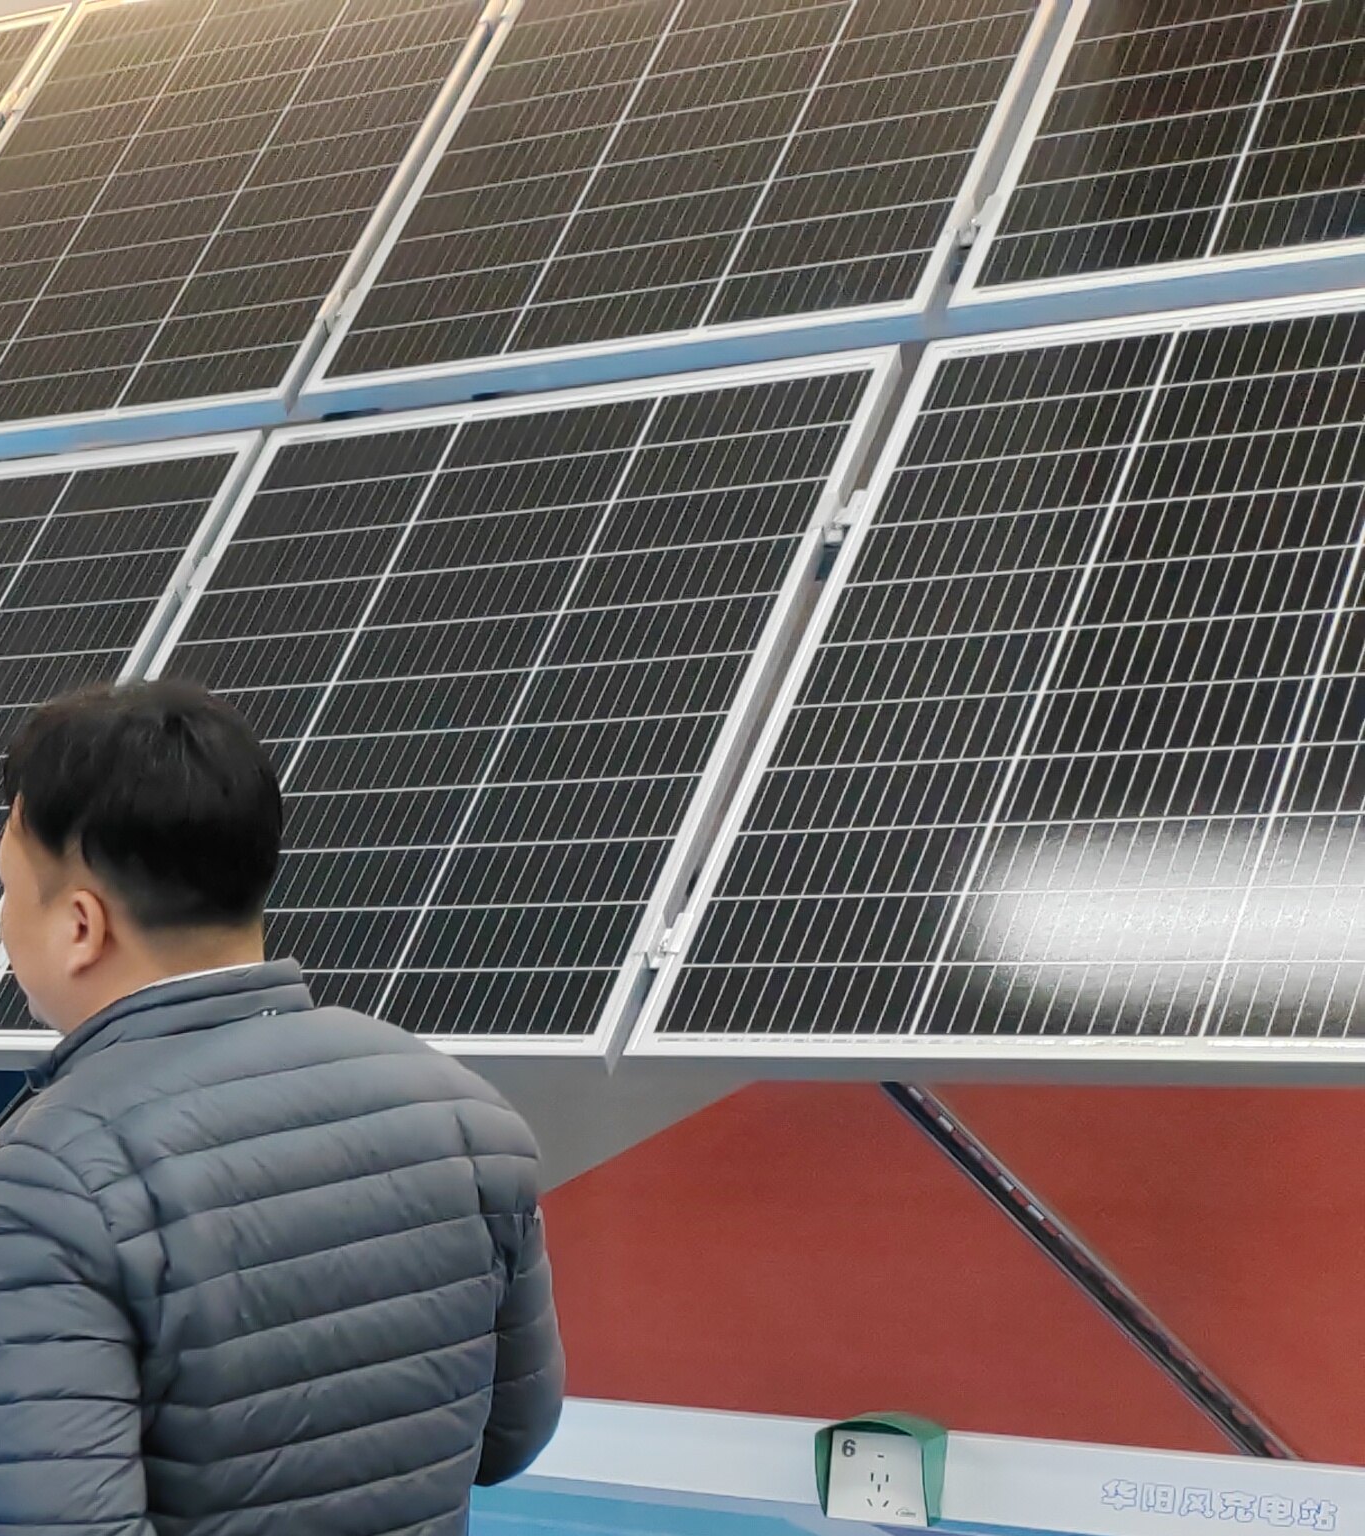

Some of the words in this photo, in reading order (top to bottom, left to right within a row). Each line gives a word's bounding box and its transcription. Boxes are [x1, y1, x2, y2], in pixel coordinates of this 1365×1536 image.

[841, 1438, 857, 1458] 6
[1100, 1478, 1339, 1532] 华阳风充电站
